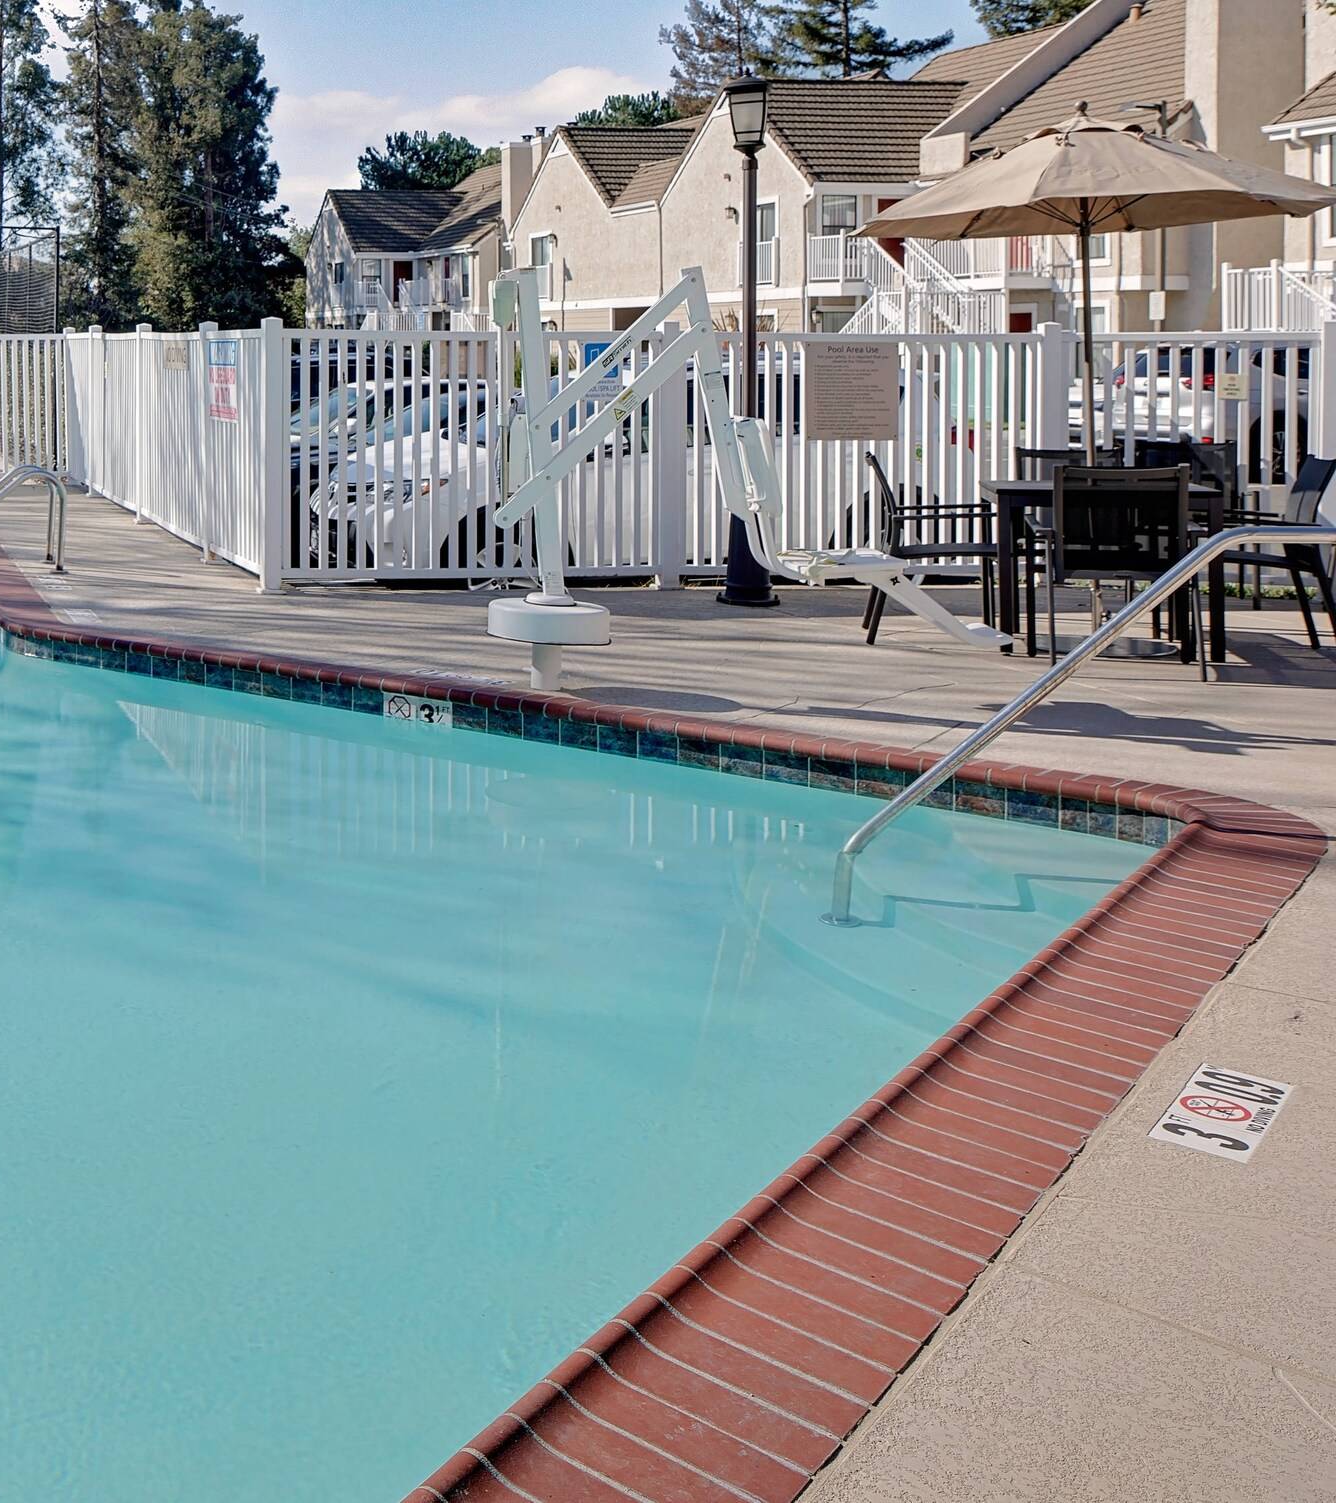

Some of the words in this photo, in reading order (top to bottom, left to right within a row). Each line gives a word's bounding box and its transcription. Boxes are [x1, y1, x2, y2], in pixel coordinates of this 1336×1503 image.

[827, 345, 844, 353] Pool
[846, 345, 864, 353] Area
[865, 345, 879, 353] Use
[419, 703, 435, 724] 3
[1161, 1122, 1251, 1152] 3
